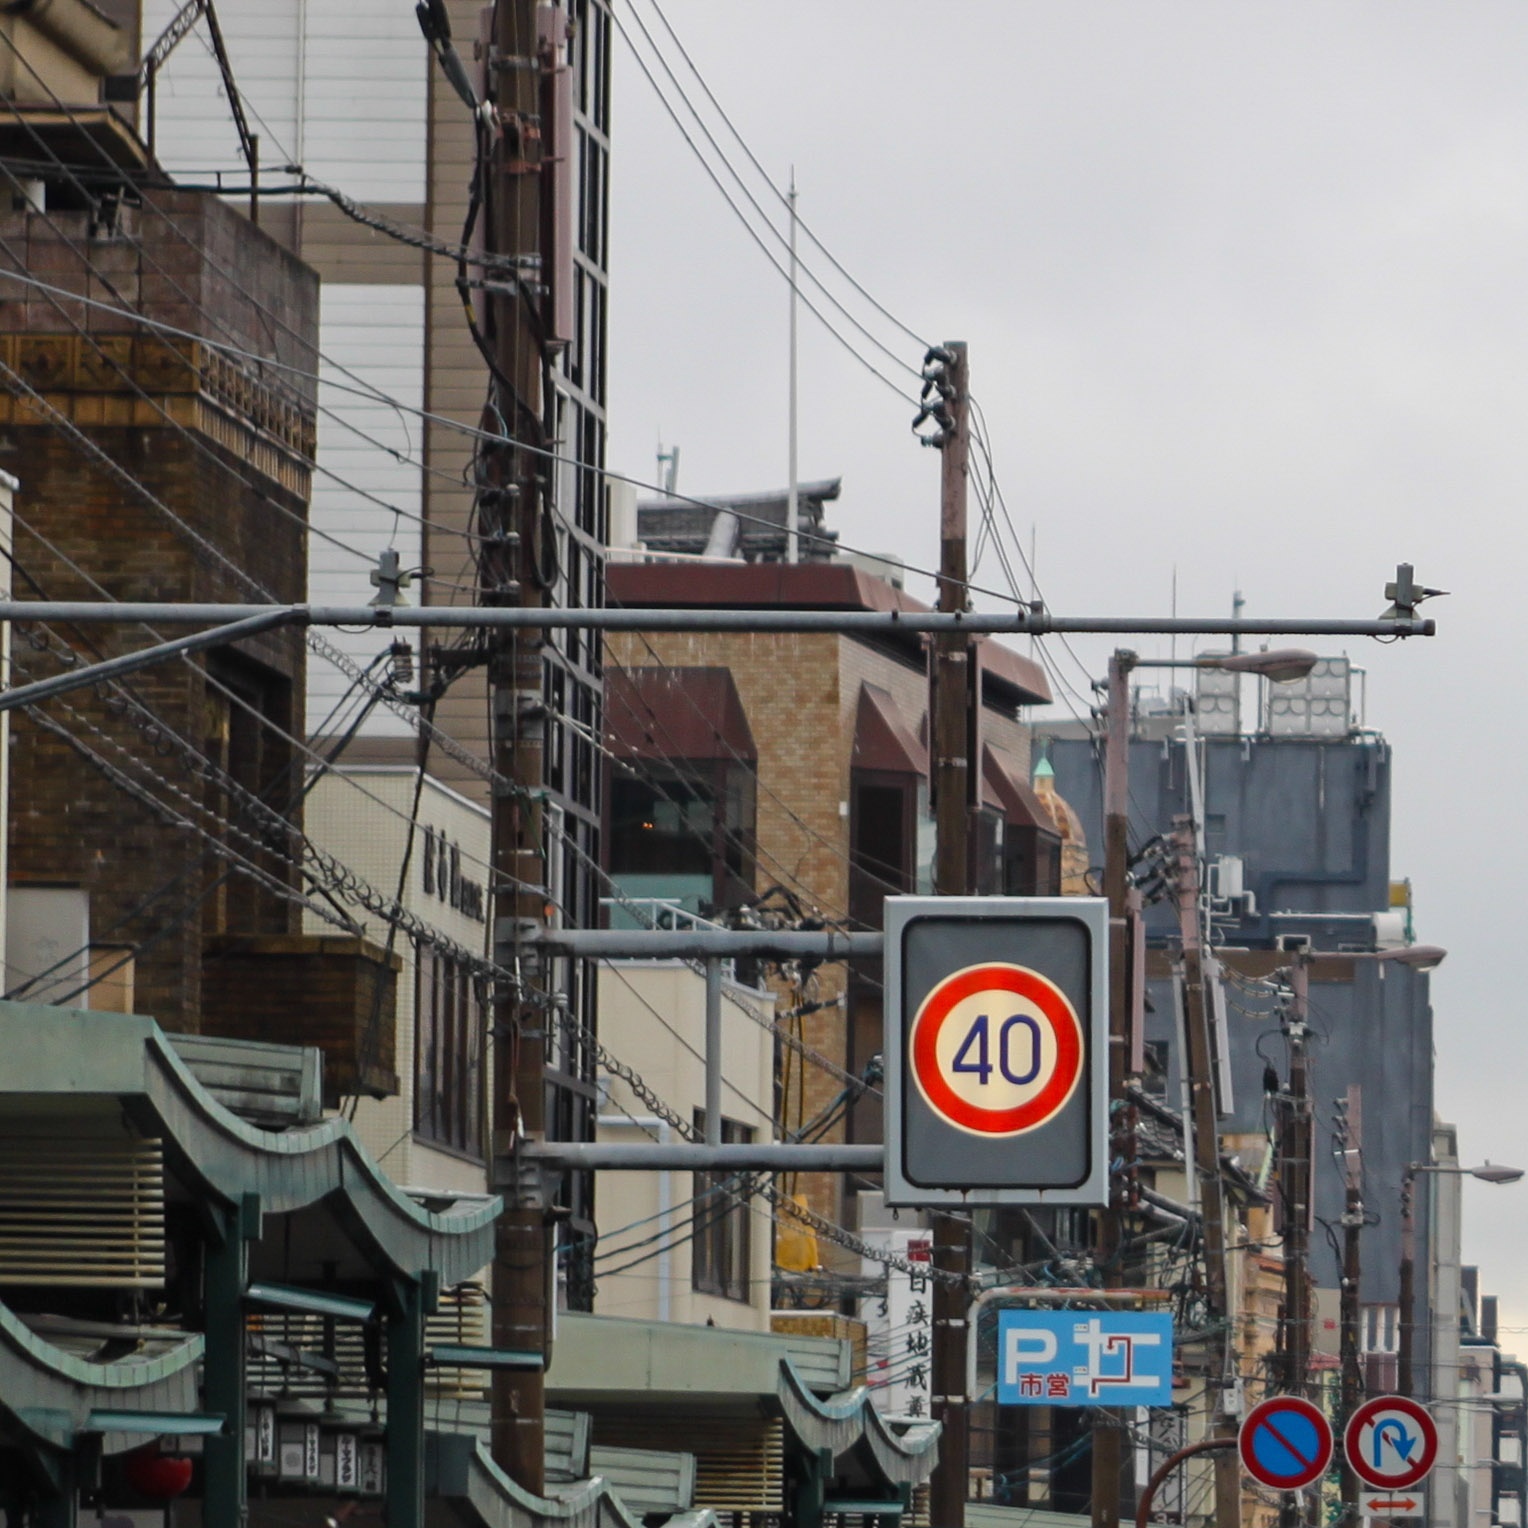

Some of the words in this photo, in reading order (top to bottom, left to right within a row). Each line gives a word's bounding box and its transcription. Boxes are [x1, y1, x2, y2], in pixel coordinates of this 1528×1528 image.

[952, 1014, 1041, 1086] 40
[1006, 1328, 1058, 1384] P
[1019, 1372, 1069, 1397] 市営
